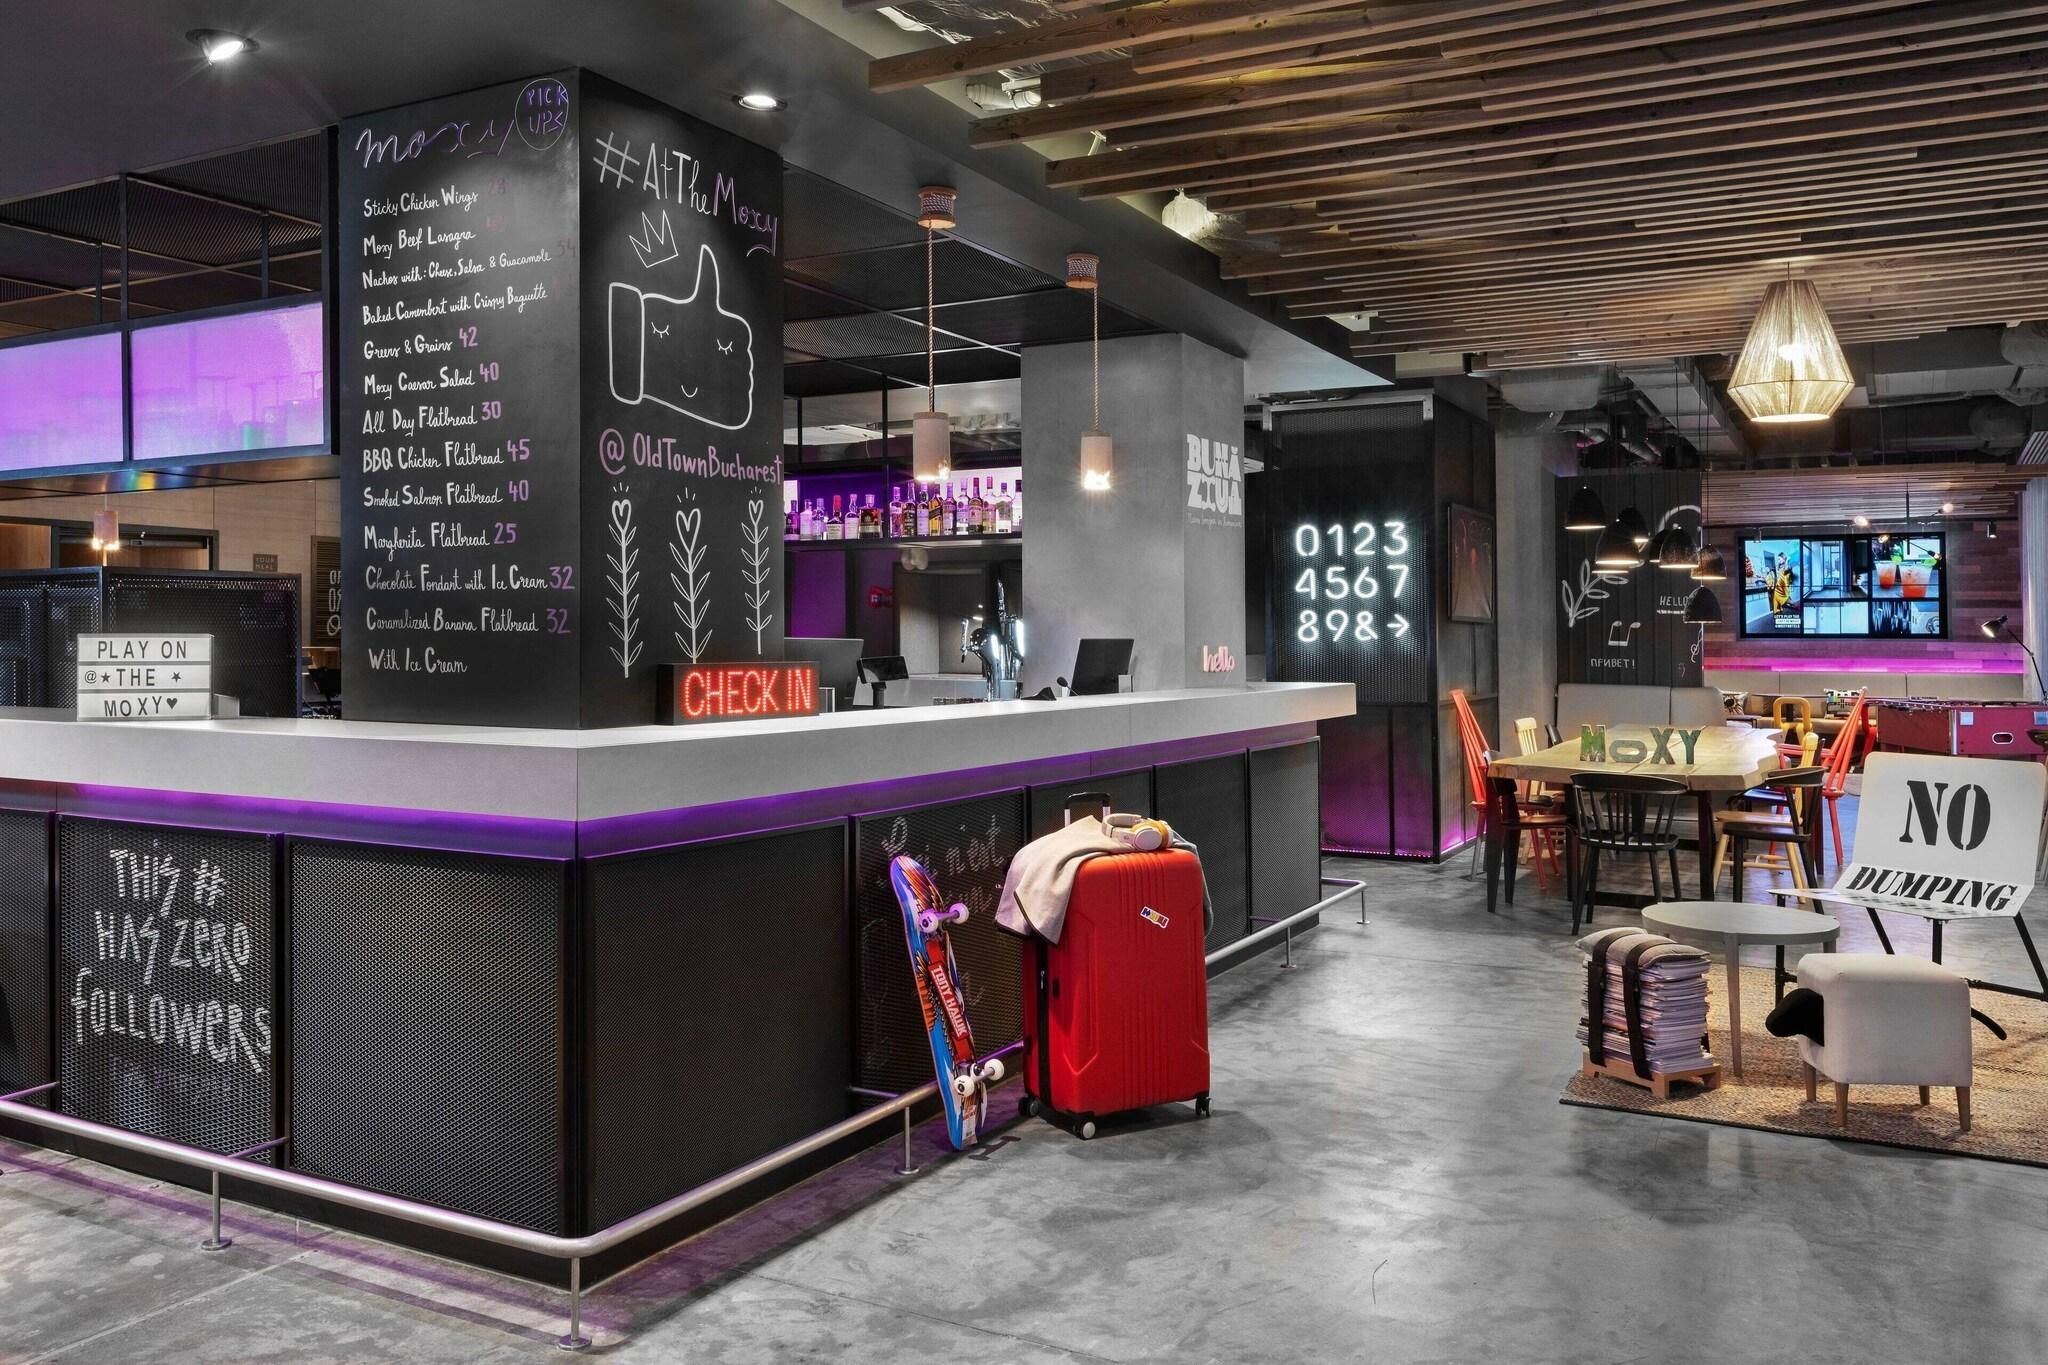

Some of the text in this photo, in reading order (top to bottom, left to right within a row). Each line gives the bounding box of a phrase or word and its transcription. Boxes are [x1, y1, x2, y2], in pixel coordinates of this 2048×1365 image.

[364, 199, 399, 217] Sticky
[400, 192, 439, 212] Chicken
[441, 185, 479, 211] Wings
[363, 226, 477, 259] Moxy Beef Lasagna
[362, 269, 398, 289] Nachos
[457, 258, 485, 276] Salsa
[489, 255, 496, 268] &
[499, 249, 552, 268] Guacamole
[363, 305, 396, 325] Baked
[449, 295, 471, 313] with
[474, 292, 505, 310] Crispy
[507, 282, 548, 313] Baguette
[404, 340, 412, 354] &
[414, 334, 453, 353] Grains
[458, 326, 479, 348] 42
[364, 362, 500, 400] Moxy Caesar Salad 40
[362, 400, 501, 437] All Day Flatbread 30
[363, 438, 531, 473] BBQ Chicken Flatbread 45
[363, 479, 529, 507] Smoked Salmon Flatbread 40
[364, 521, 517, 561] Margherita Flatbread 25
[365, 563, 576, 592] Chocolate Fondant with Ice Cream 32
[1660, 595, 1689, 607] HELLO
[366, 606, 572, 634] Caramelized Banana Flatbread 32
[98, 640, 187, 659] PLAY ON
[368, 646, 468, 674] With Ice Cream
[1203, 645, 1235, 673] hello
[116, 668, 155, 686] THE
[684, 669, 812, 717] CHECK IN
[104, 696, 162, 717] MOXY
[1899, 780, 1991, 851] NO
[1846, 866, 2018, 912] DUMPING
